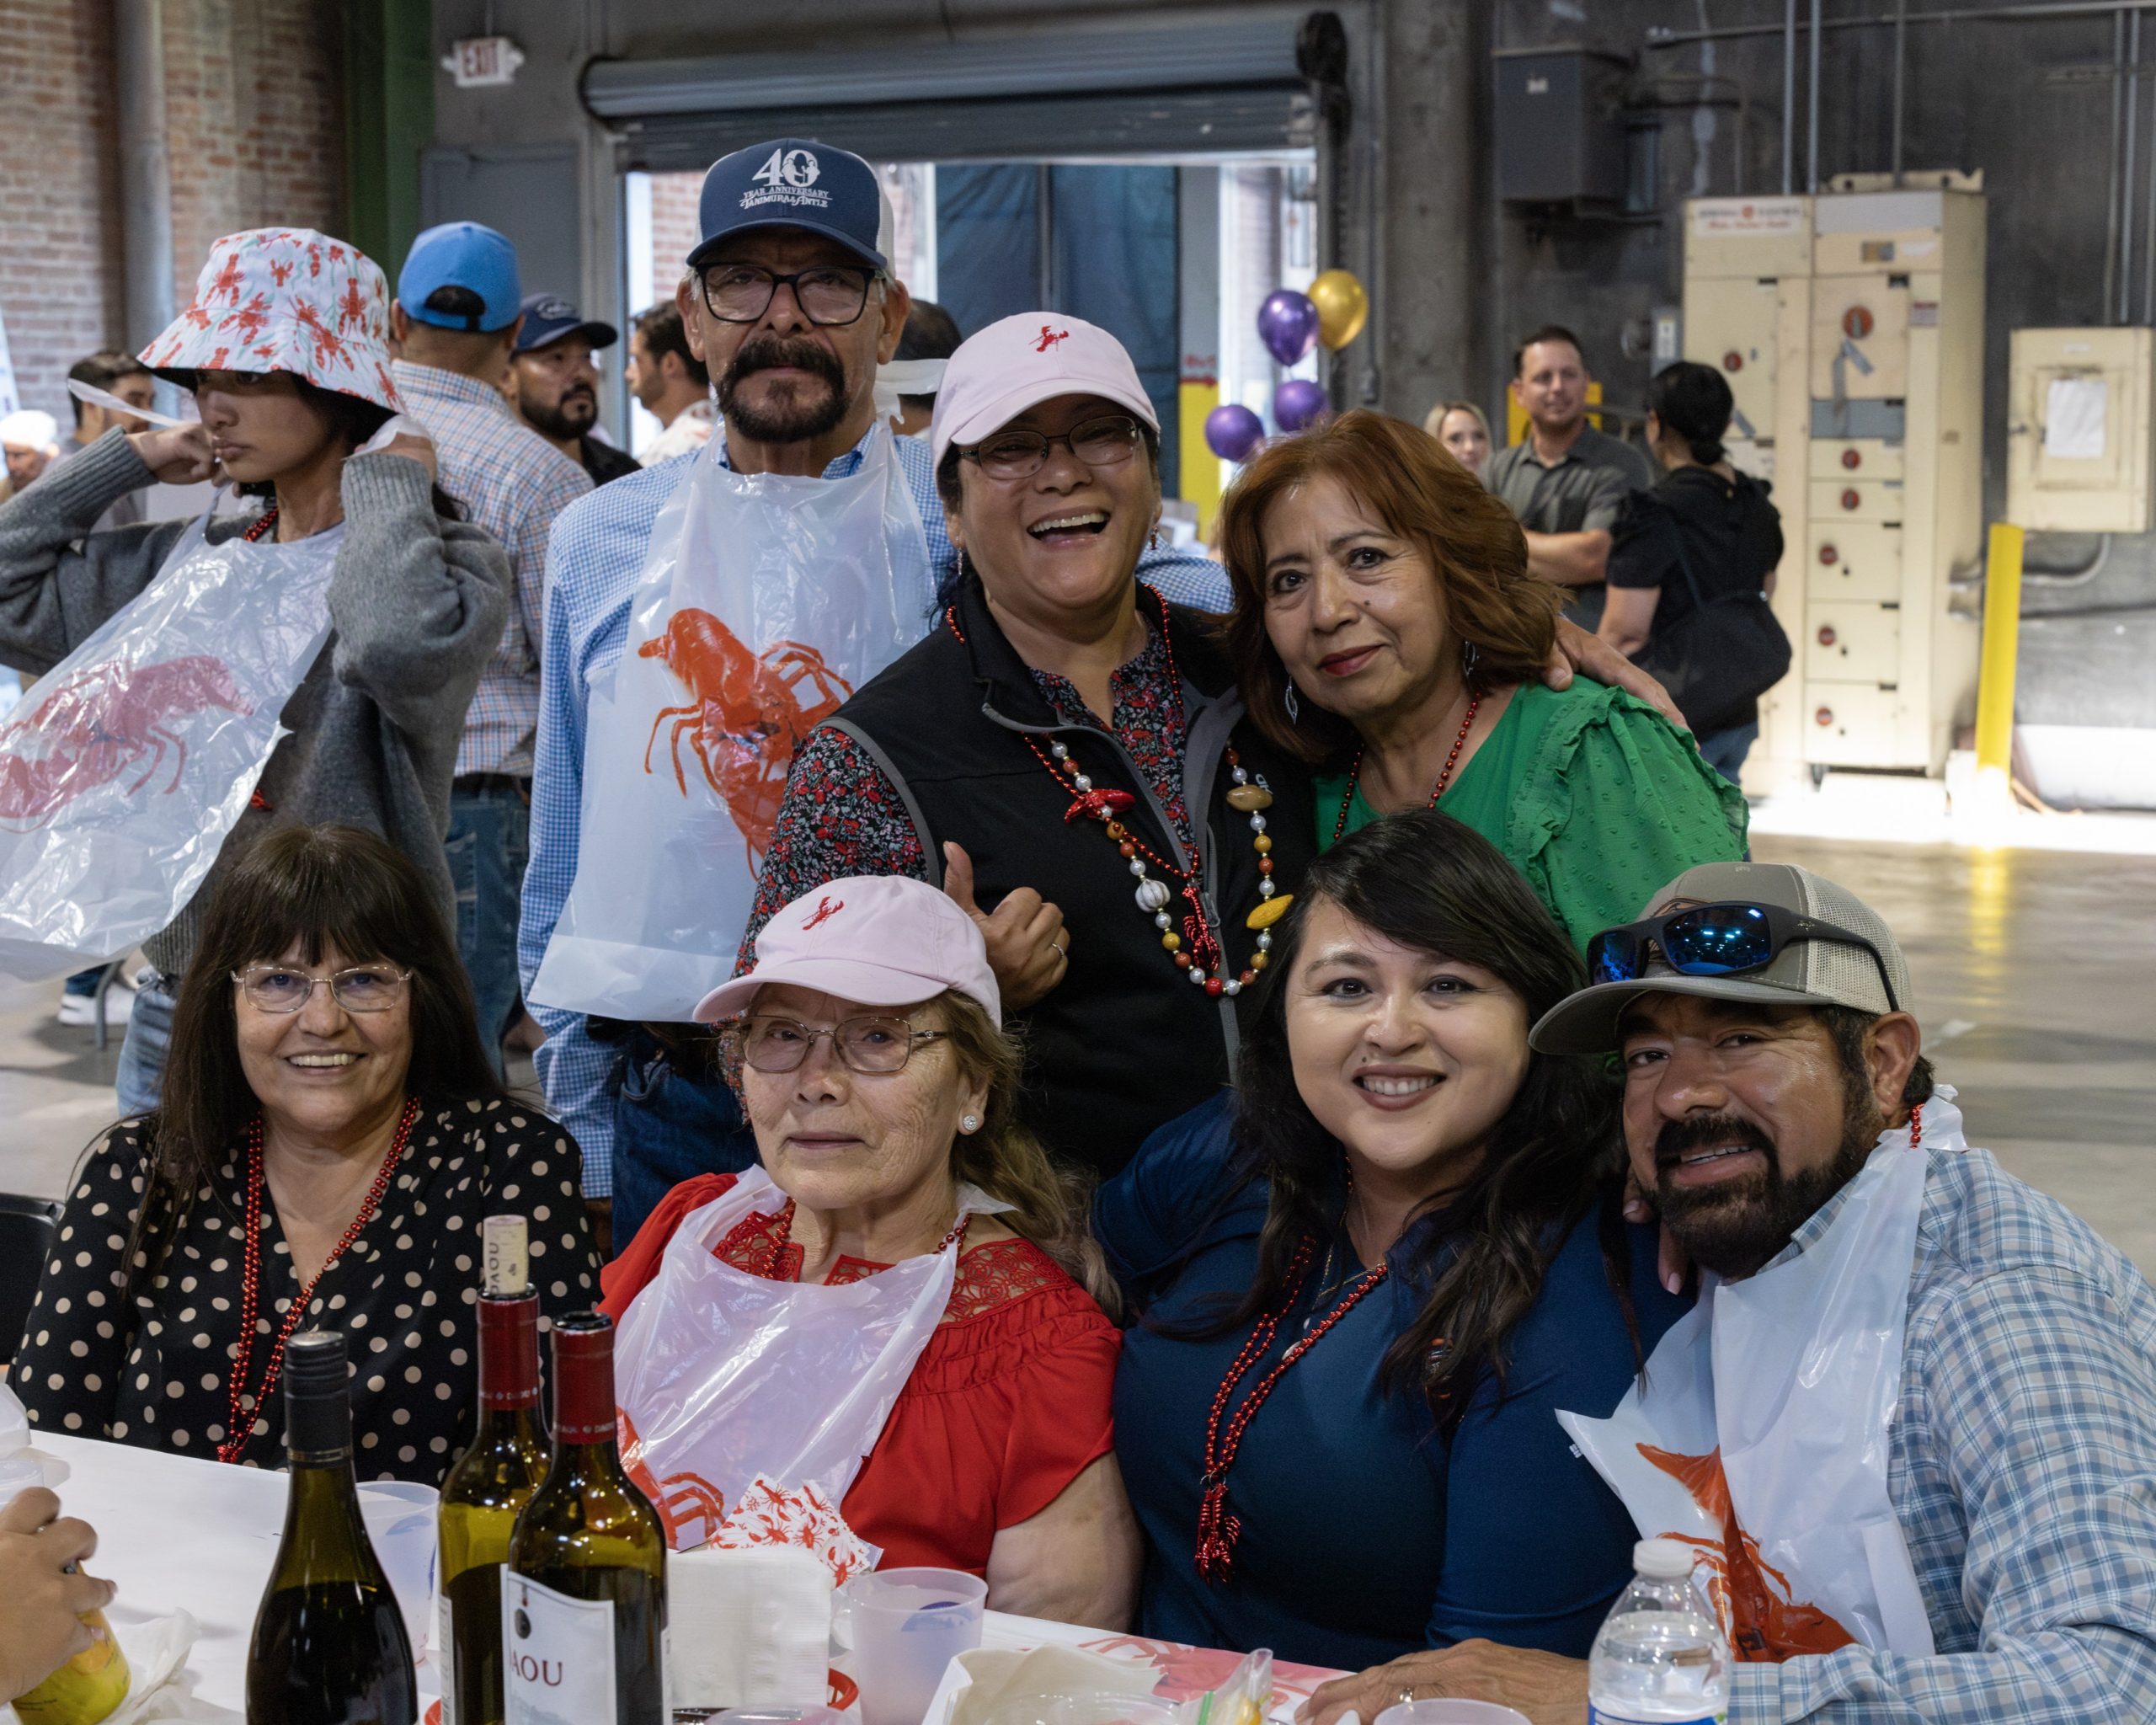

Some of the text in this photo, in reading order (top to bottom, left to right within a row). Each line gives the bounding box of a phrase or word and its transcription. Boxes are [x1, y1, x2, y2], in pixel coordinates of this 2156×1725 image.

[751, 147, 821, 187] 40
[743, 186, 830, 200] YEAR ANNIVERSARY
